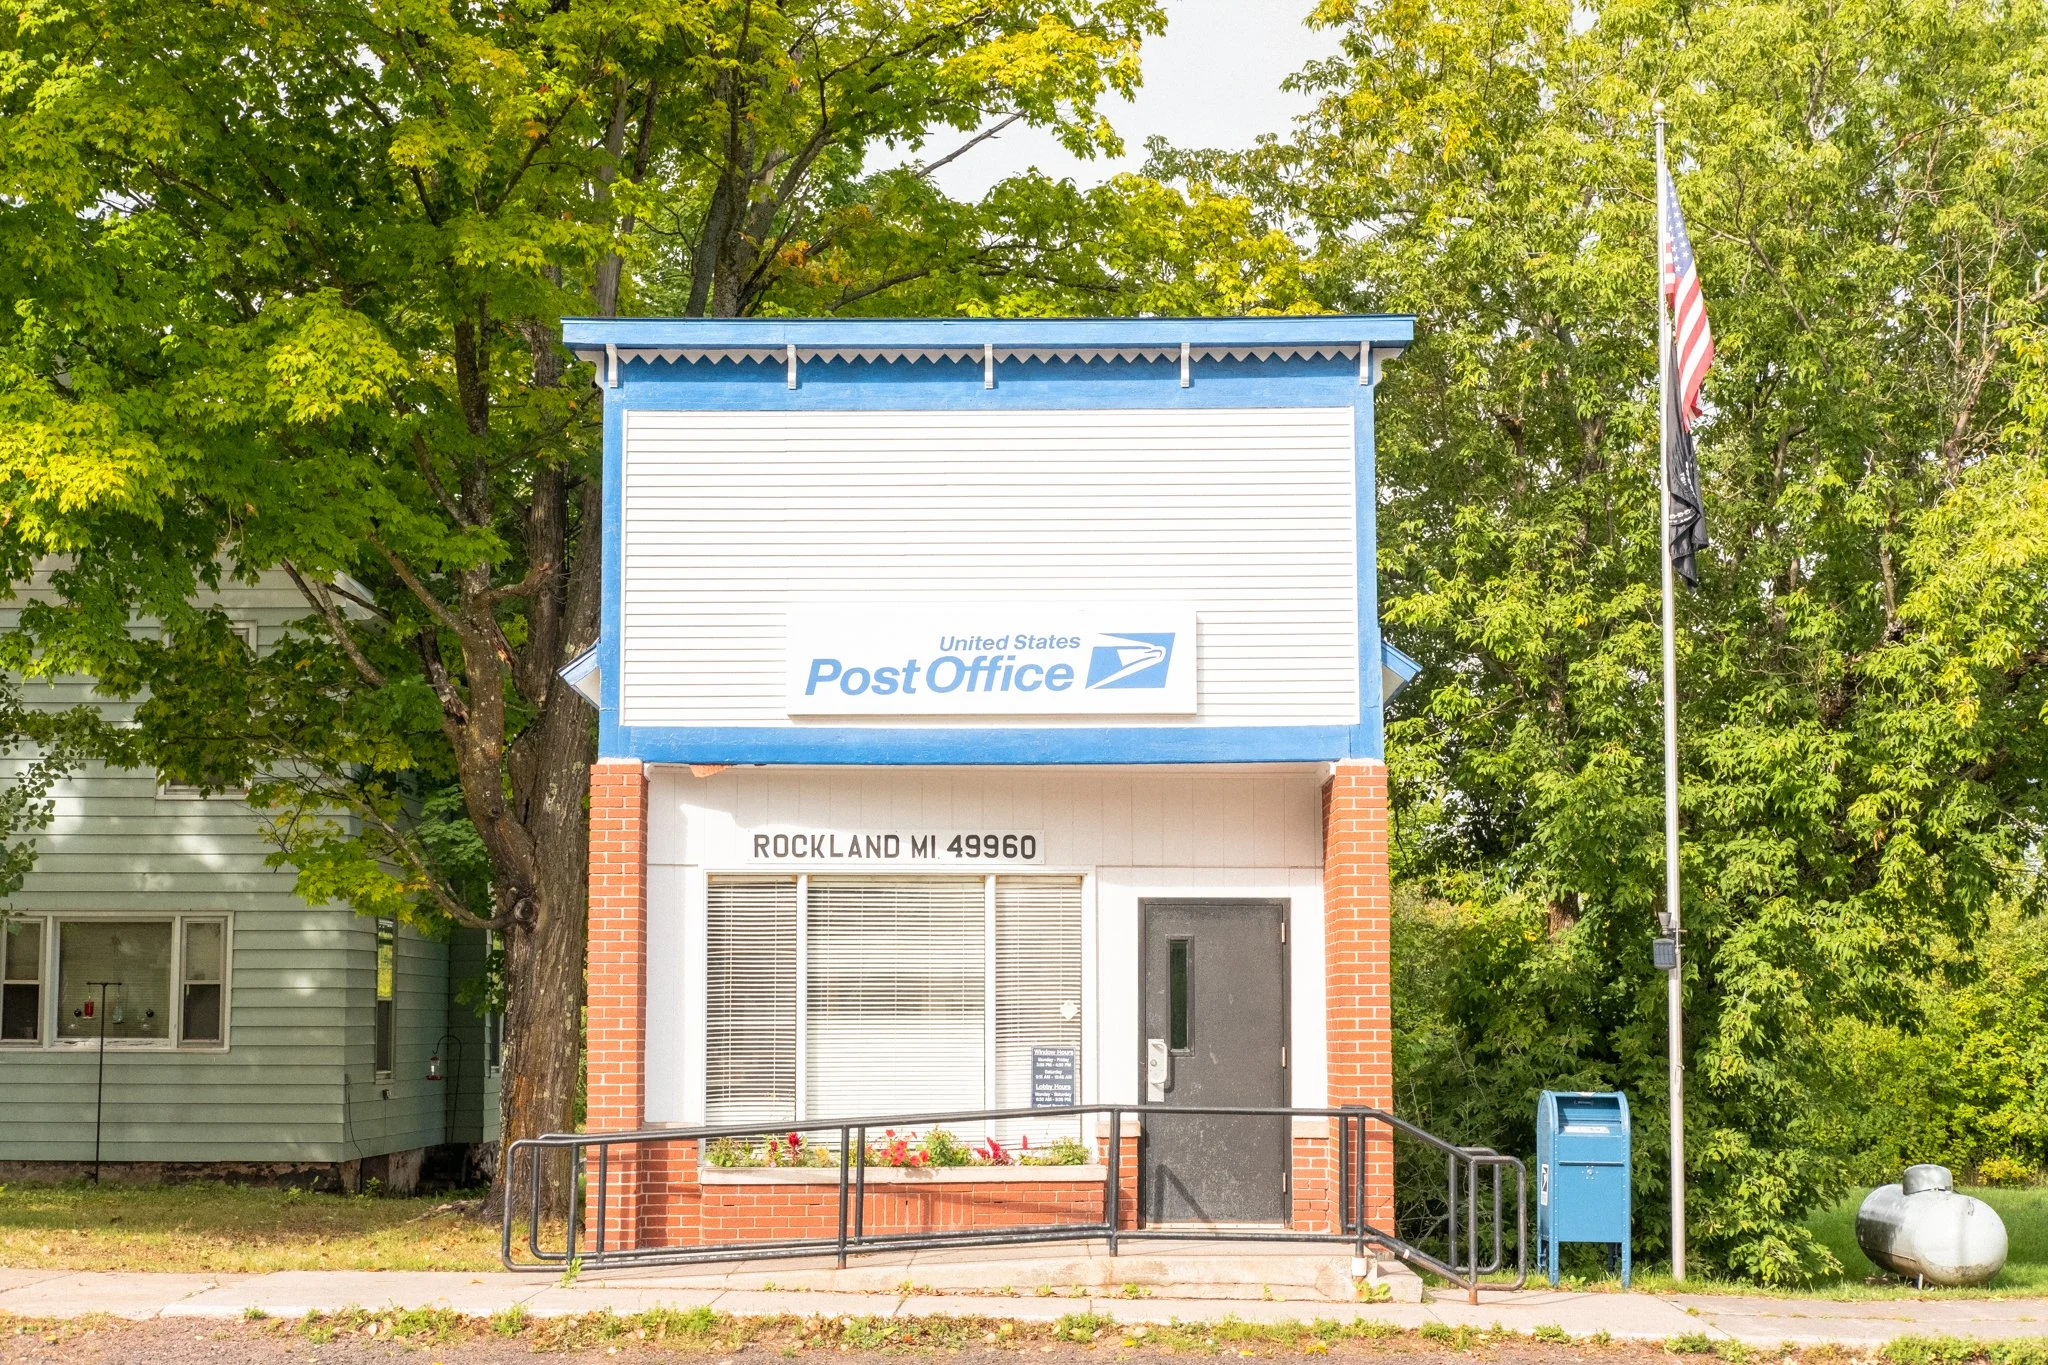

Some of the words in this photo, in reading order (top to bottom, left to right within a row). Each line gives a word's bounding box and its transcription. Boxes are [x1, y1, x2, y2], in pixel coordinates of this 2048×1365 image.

[940, 634, 1009, 652] United
[1014, 633, 1081, 651] States
[804, 658, 921, 696] Post
[926, 654, 1075, 694] Office
[753, 834, 900, 858] ROCKLAND
[946, 834, 1036, 859] 49960
[1036, 1083, 1053, 1091] Lobby
